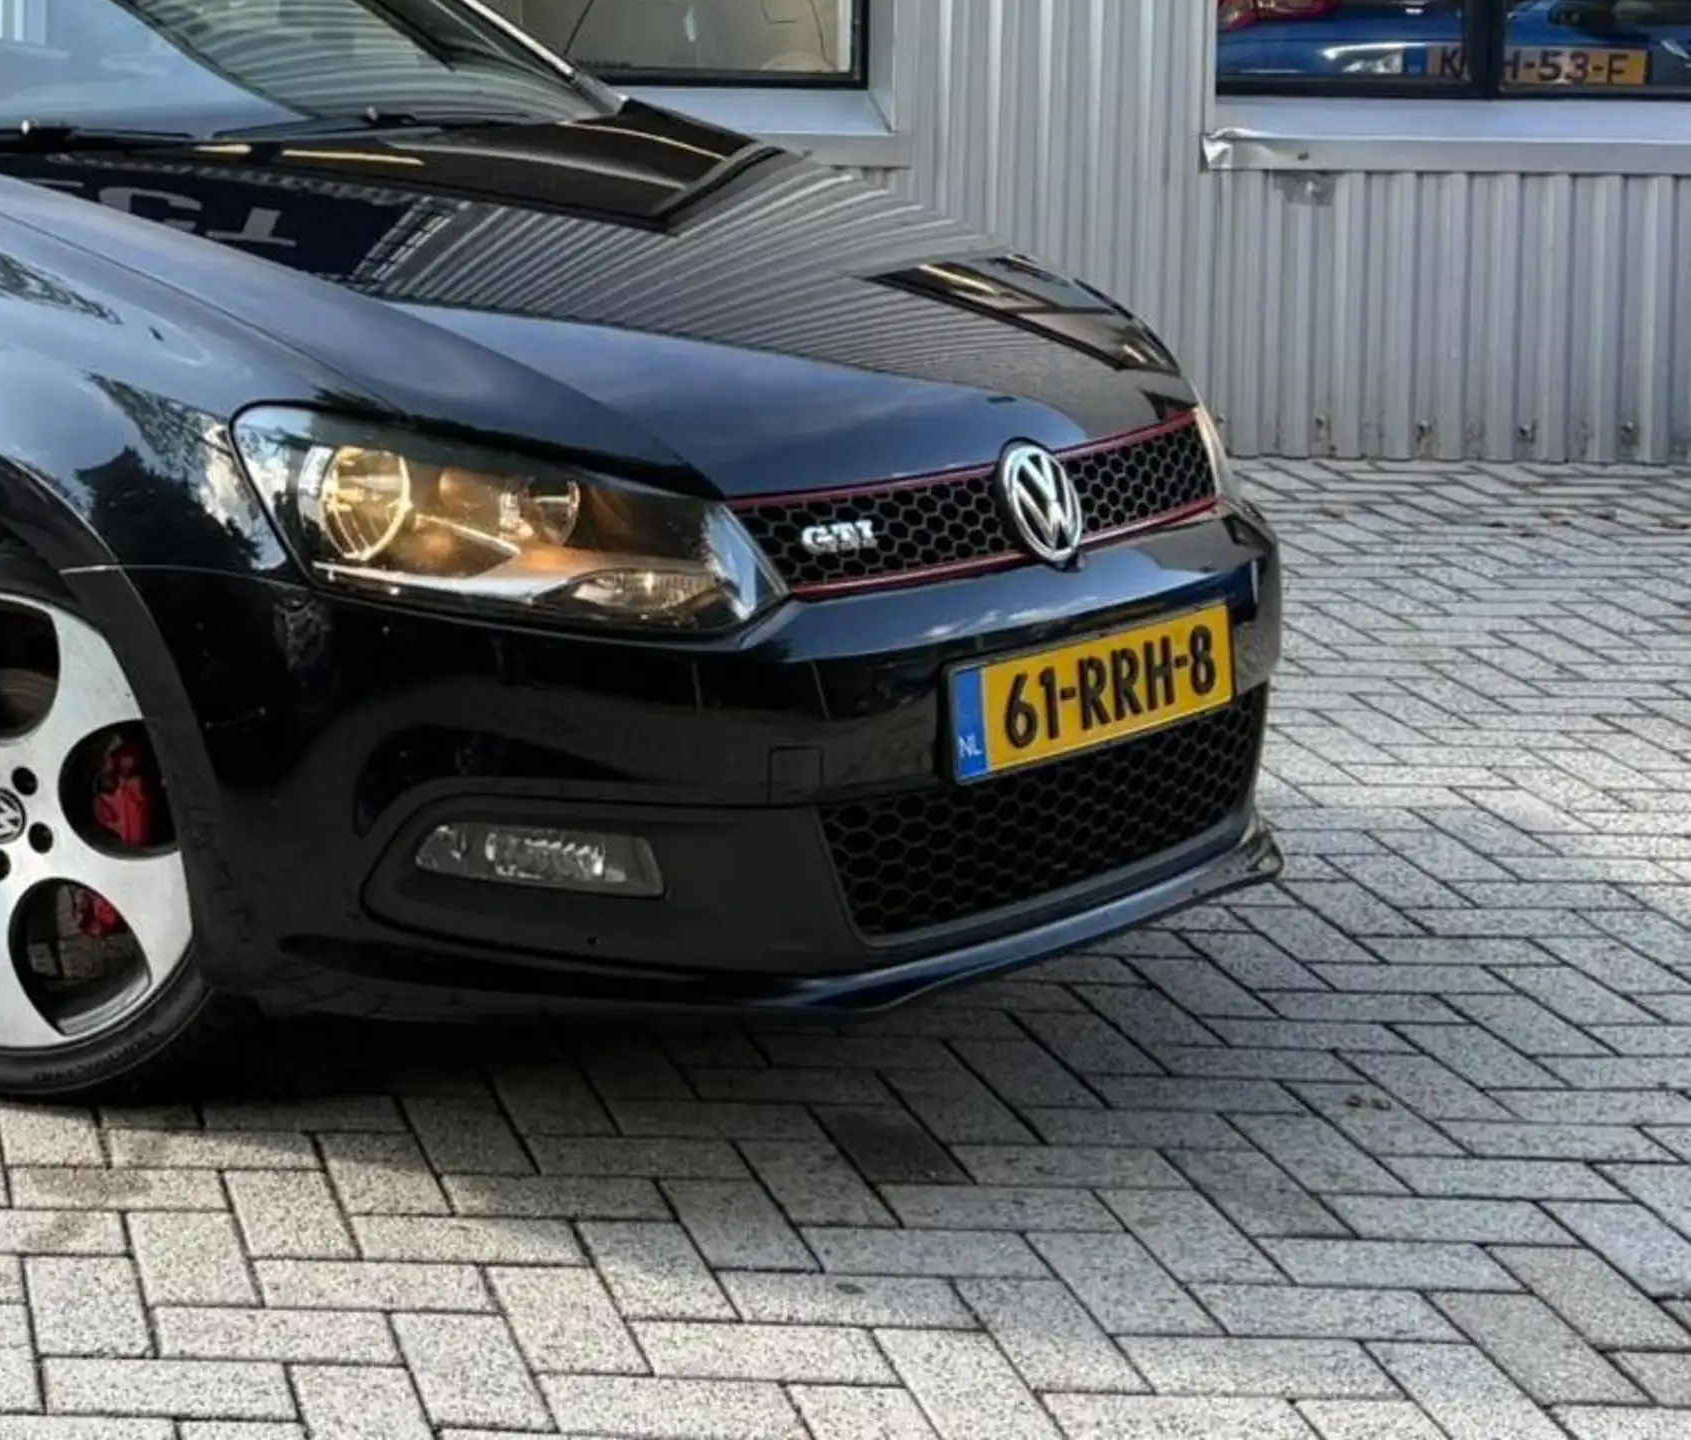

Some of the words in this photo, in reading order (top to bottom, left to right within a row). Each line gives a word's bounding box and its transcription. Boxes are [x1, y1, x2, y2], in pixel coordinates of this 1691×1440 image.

[1440, 46, 1628, 85] KH-53-F
[801, 519, 877, 555] GTI
[1004, 624, 1216, 749] 61-RRH-8
[957, 732, 983, 759] NL
